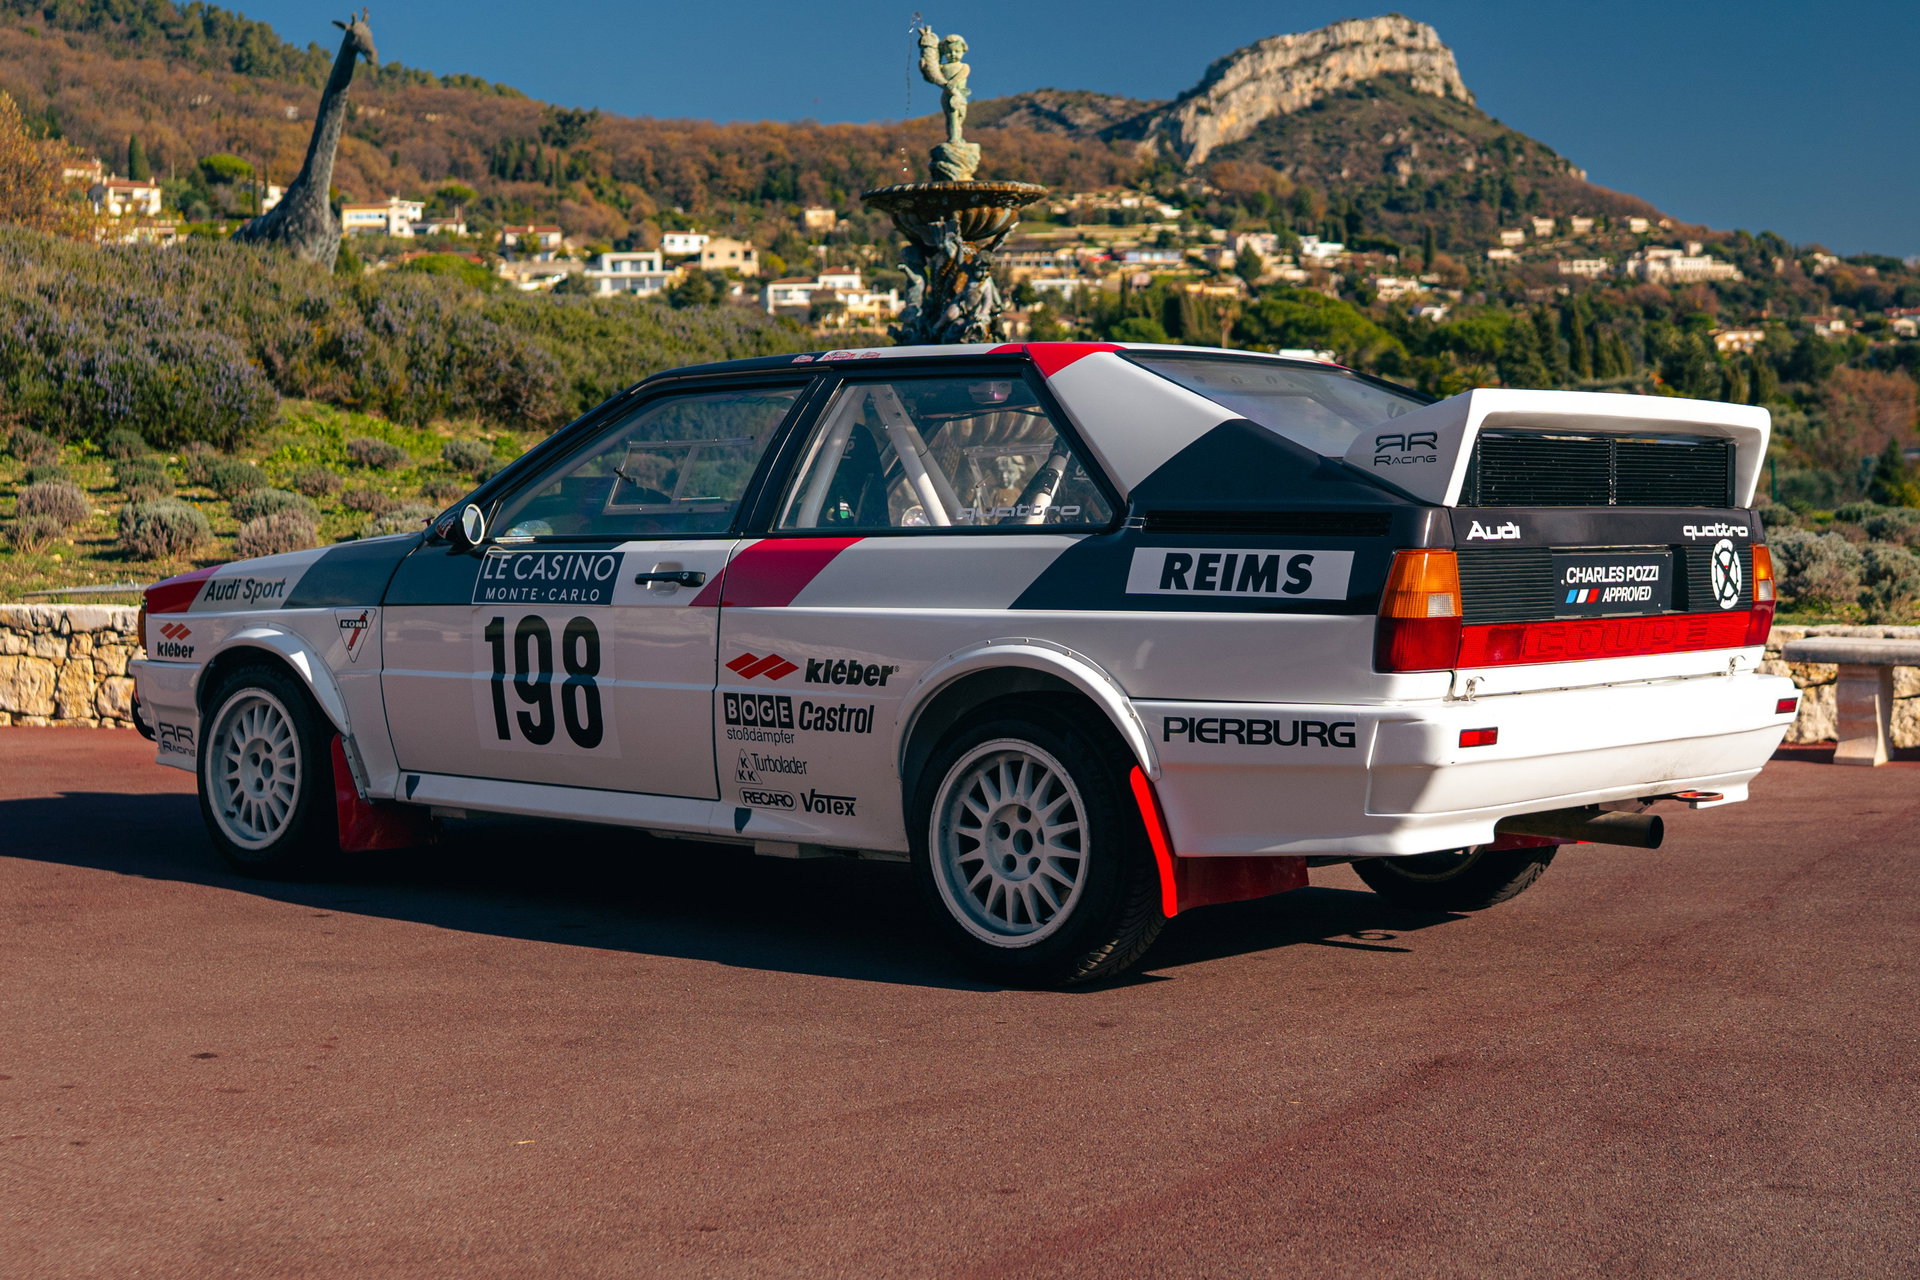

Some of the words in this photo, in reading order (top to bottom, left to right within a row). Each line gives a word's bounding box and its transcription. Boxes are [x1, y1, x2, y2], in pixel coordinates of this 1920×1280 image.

[956, 503, 1081, 521] quattro
[1466, 521, 1521, 540] Audi
[1683, 523, 1748, 540] quattro
[483, 554, 512, 580] LE
[514, 554, 616, 581] CASINO
[1159, 552, 1315, 595] REIMS
[1566, 566, 1624, 584] CHARLES
[1626, 565, 1659, 582] POZZI
[204, 579, 242, 601] Audi
[243, 578, 286, 604] Sport
[1602, 586, 1652, 603] APPROVED
[342, 620, 367, 628] KONI
[485, 615, 604, 749] 198
[726, 698, 791, 723] BOGE
[799, 700, 875, 733] Castrol
[1163, 716, 1357, 748] PIERBURG
[751, 753, 807, 775] Turbolader
[742, 790, 794, 808] RECARO
